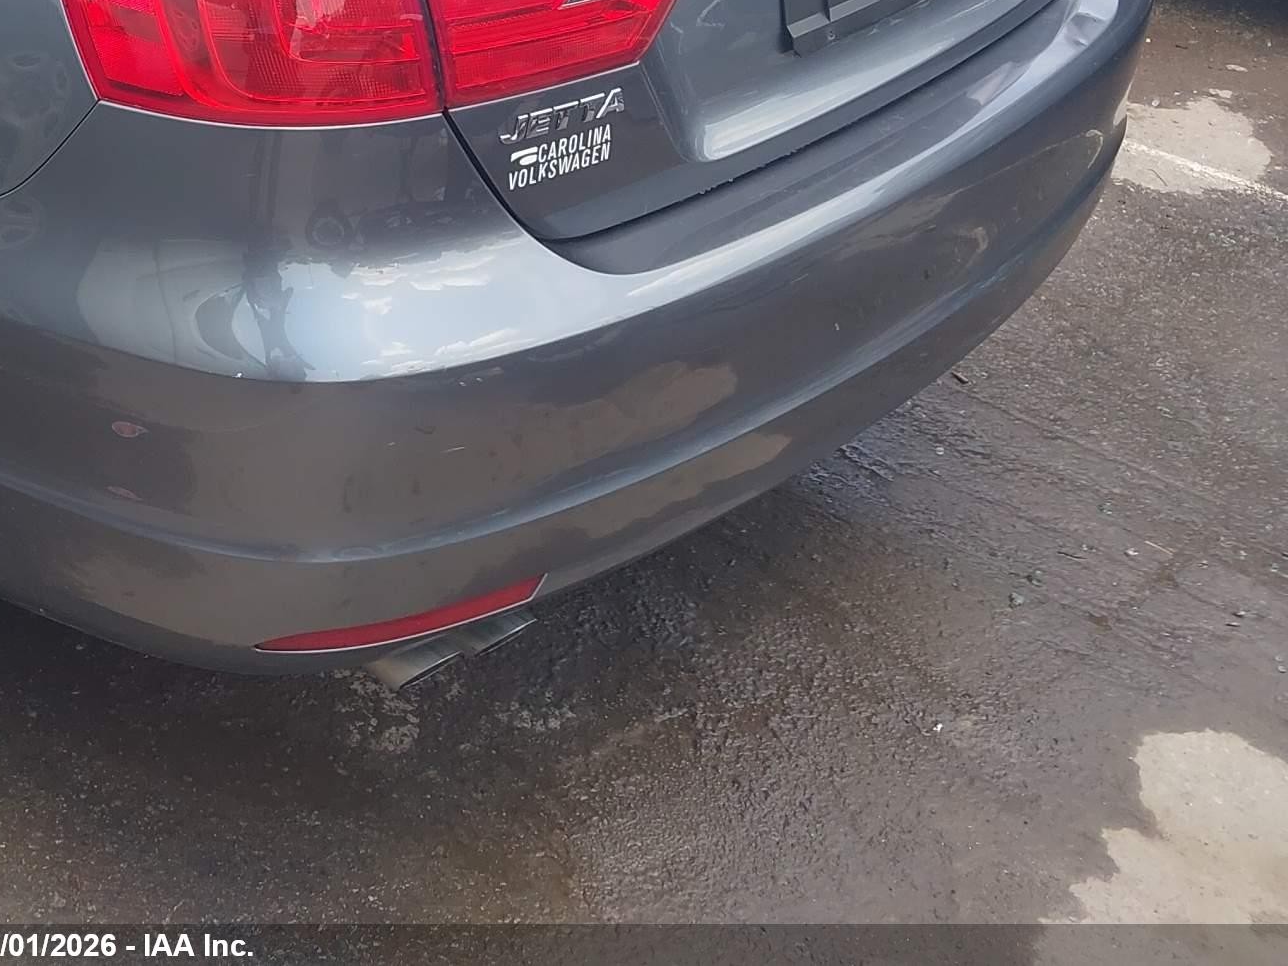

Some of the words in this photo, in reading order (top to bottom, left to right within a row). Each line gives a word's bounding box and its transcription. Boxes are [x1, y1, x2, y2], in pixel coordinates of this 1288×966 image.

[498, 87, 625, 145] JETTA
[508, 141, 612, 191] VOLKSWAGEN
[537, 123, 612, 163] CAROLINA
